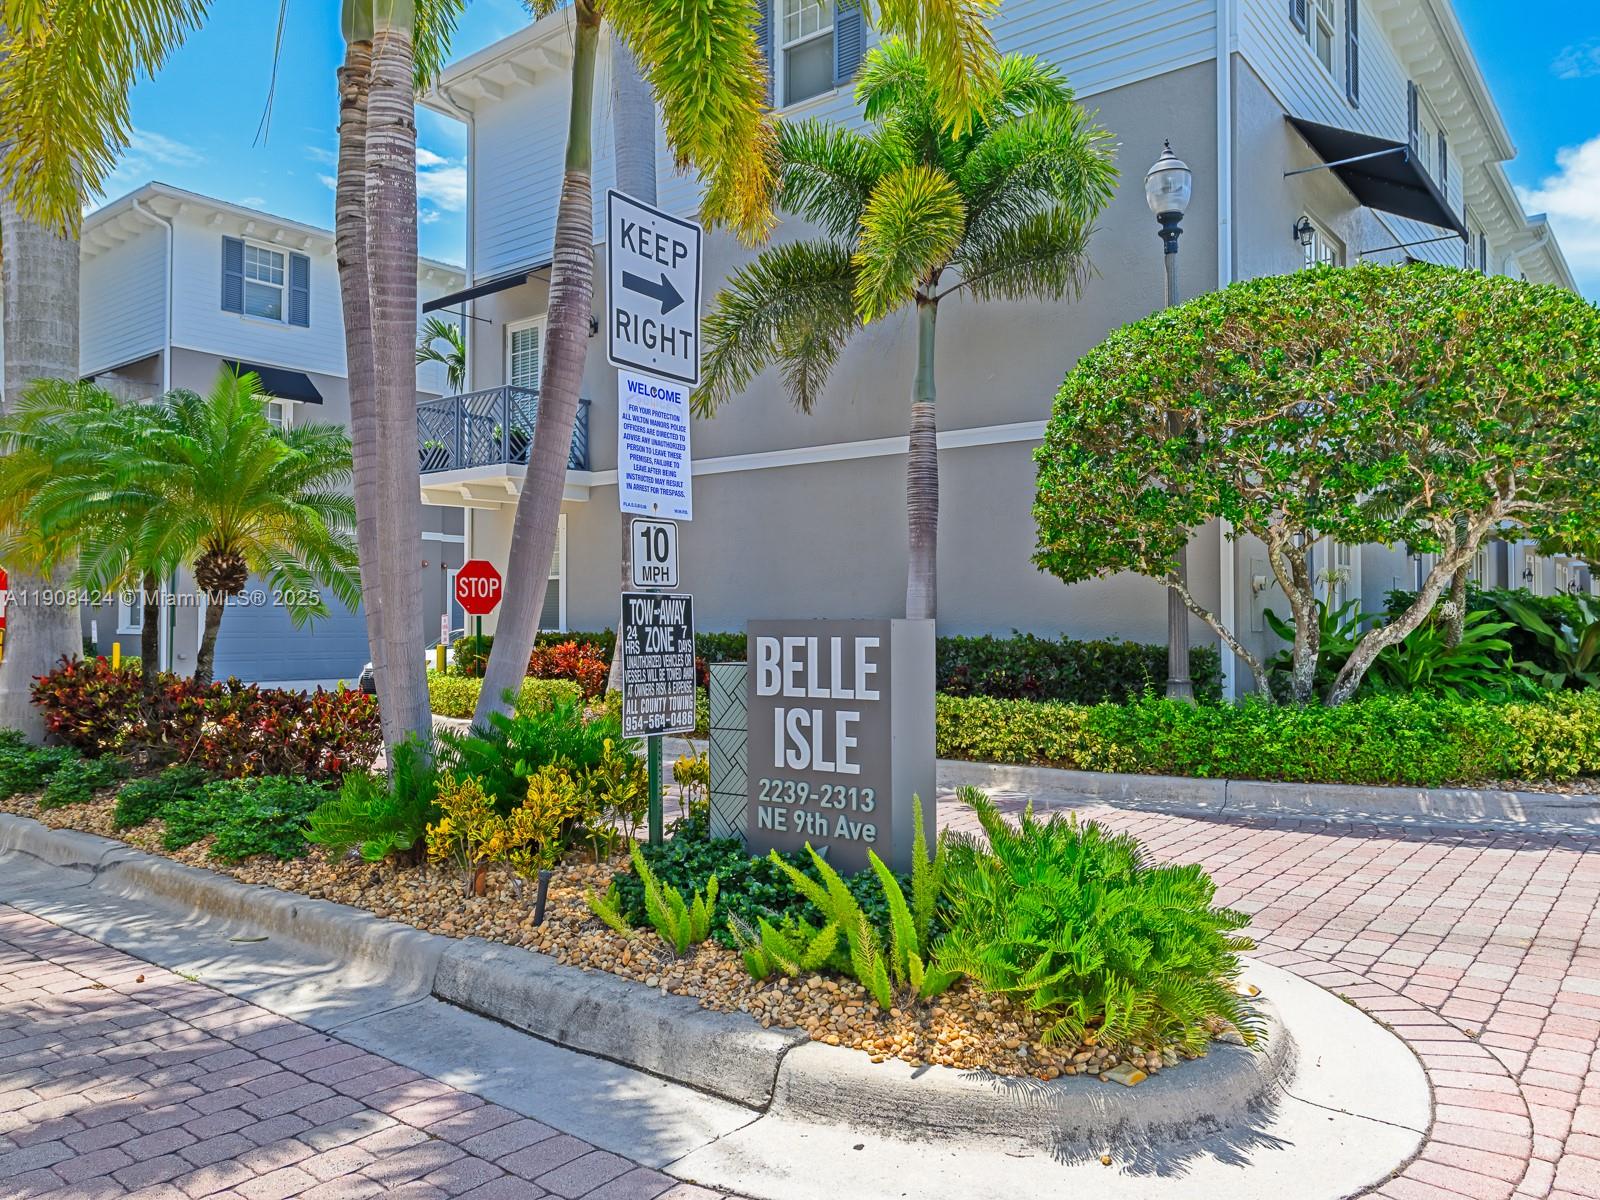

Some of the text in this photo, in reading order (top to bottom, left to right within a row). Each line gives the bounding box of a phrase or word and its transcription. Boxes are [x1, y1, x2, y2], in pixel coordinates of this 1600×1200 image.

[621, 218, 688, 269] KEEP
[616, 308, 692, 360] RIGHT
[627, 379, 681, 404] WELCOME
[629, 404, 680, 422] FOR YOUR PROTECTION
[622, 413, 687, 433] ALL WILTON MANORS POLICE
[623, 423, 645, 434] OFFICERS
[646, 428, 656, 436] ARE
[655, 430, 679, 441] DIRECTED
[623, 433, 686, 451] ADVISE ANY UNAUTHORIZED
[627, 443, 645, 453] PERSON
[652, 448, 666, 458] LEAVE
[668, 451, 682, 460] THESE
[634, 464, 677, 477] LEAVE AFTER BEING
[654, 459, 672, 468] FAILURE
[626, 473, 654, 483] INSTRUCTED
[666, 480, 683, 488] RESULT
[633, 484, 650, 492] ARREST
[641, 526, 669, 563] 10
[643, 566, 669, 582] MPH
[459, 577, 499, 598] STOP
[627, 625, 637, 639] 24
[645, 626, 674, 652] ZONE
[682, 625, 687, 639] 7
[625, 640, 640, 654] HRS
[677, 640, 691, 652] DAYS
[627, 654, 691, 669] UNAUTHORIZED VEHICLES OR
[756, 636, 880, 701] BELLE
[625, 669, 646, 683] VESSELS
[647, 669, 658, 681] WILL
[659, 668, 665, 681] BE
[667, 668, 682, 680] TOWED
[627, 684, 633, 697] AT
[656, 682, 666, 695] RISK
[672, 680, 692, 693] EXPENSE
[626, 695, 693, 715] ALL COUNTY TOWING
[626, 711, 693, 731] 954-564-0486
[774, 707, 860, 775] ISLE
[758, 778, 876, 812] 2239-2313
[758, 806, 877, 843] NE 9th Ave
